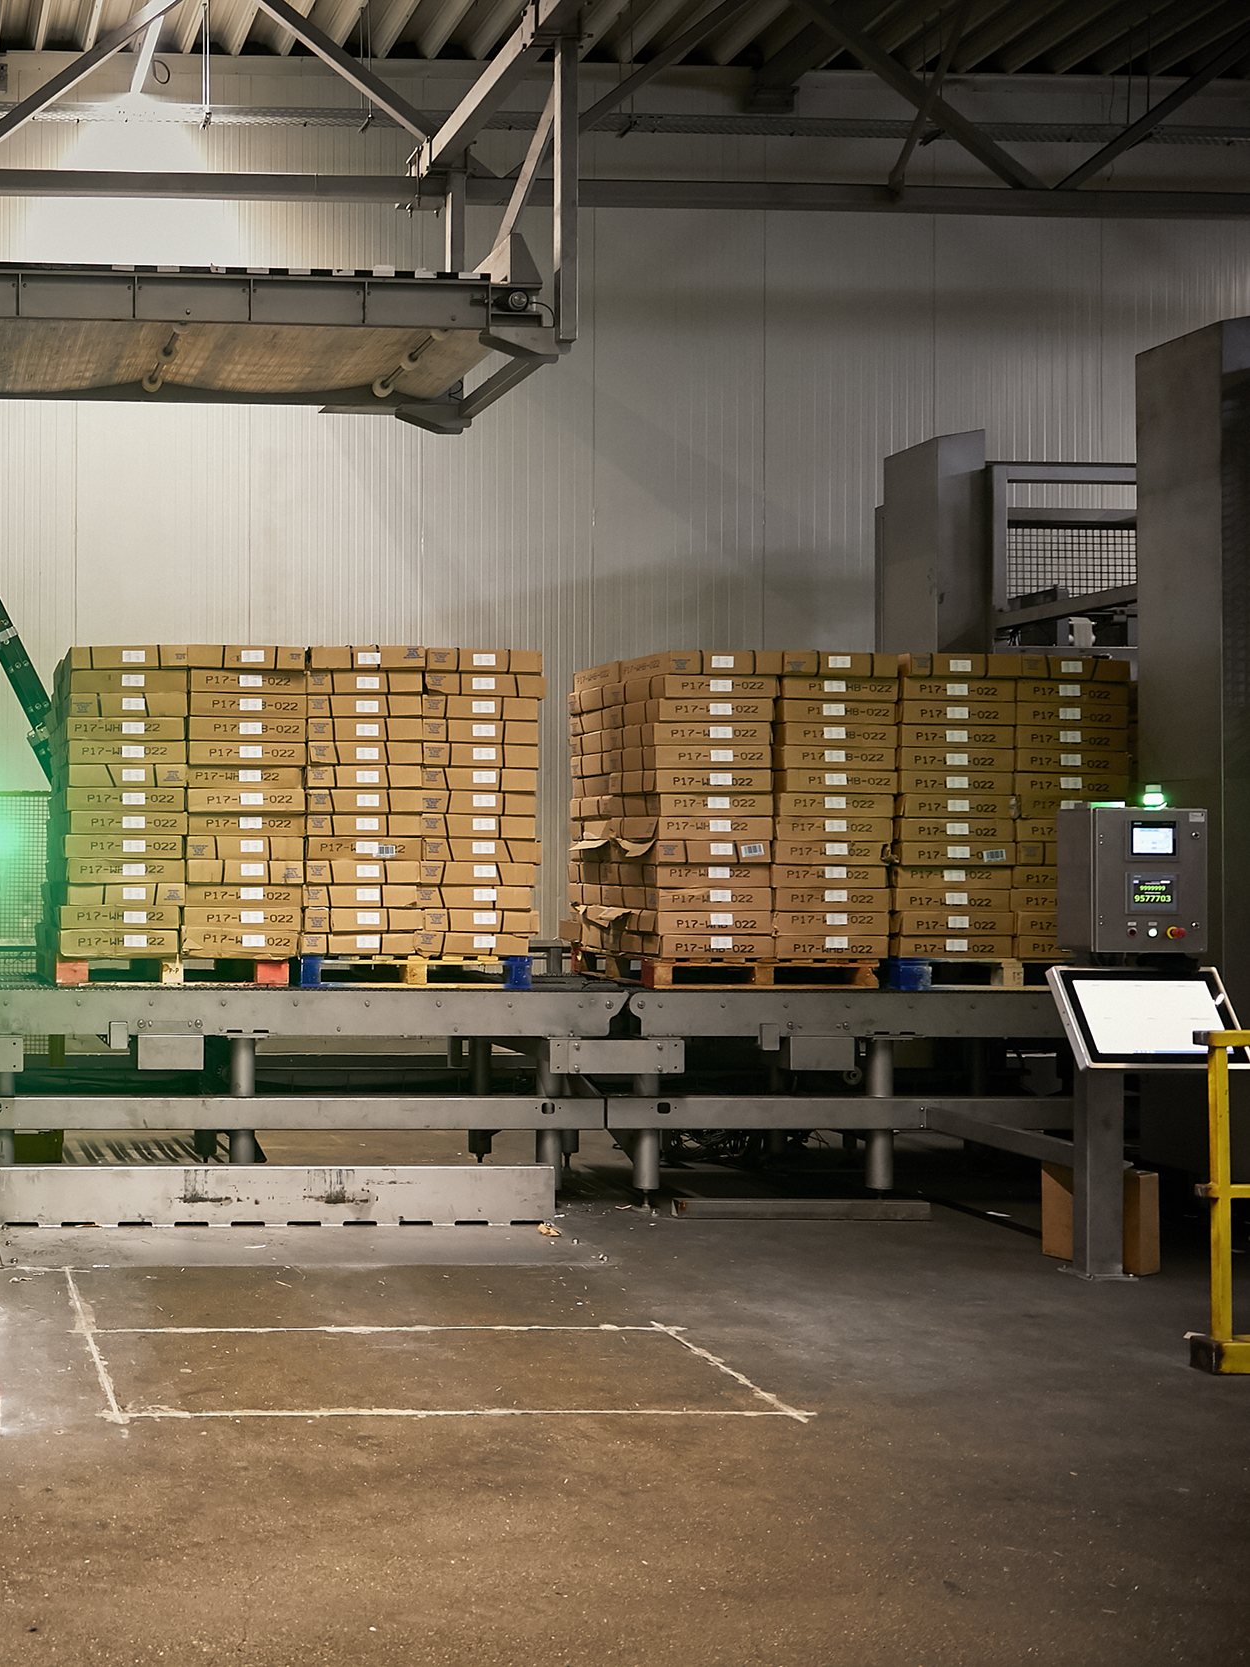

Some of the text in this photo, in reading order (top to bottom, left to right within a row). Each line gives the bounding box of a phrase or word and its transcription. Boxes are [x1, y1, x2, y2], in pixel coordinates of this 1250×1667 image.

[678, 751, 763, 761] P17--022
[91, 818, 177, 828] P17--022
[90, 842, 177, 851] P17--022
[1133, 894, 1172, 903] 9577703
